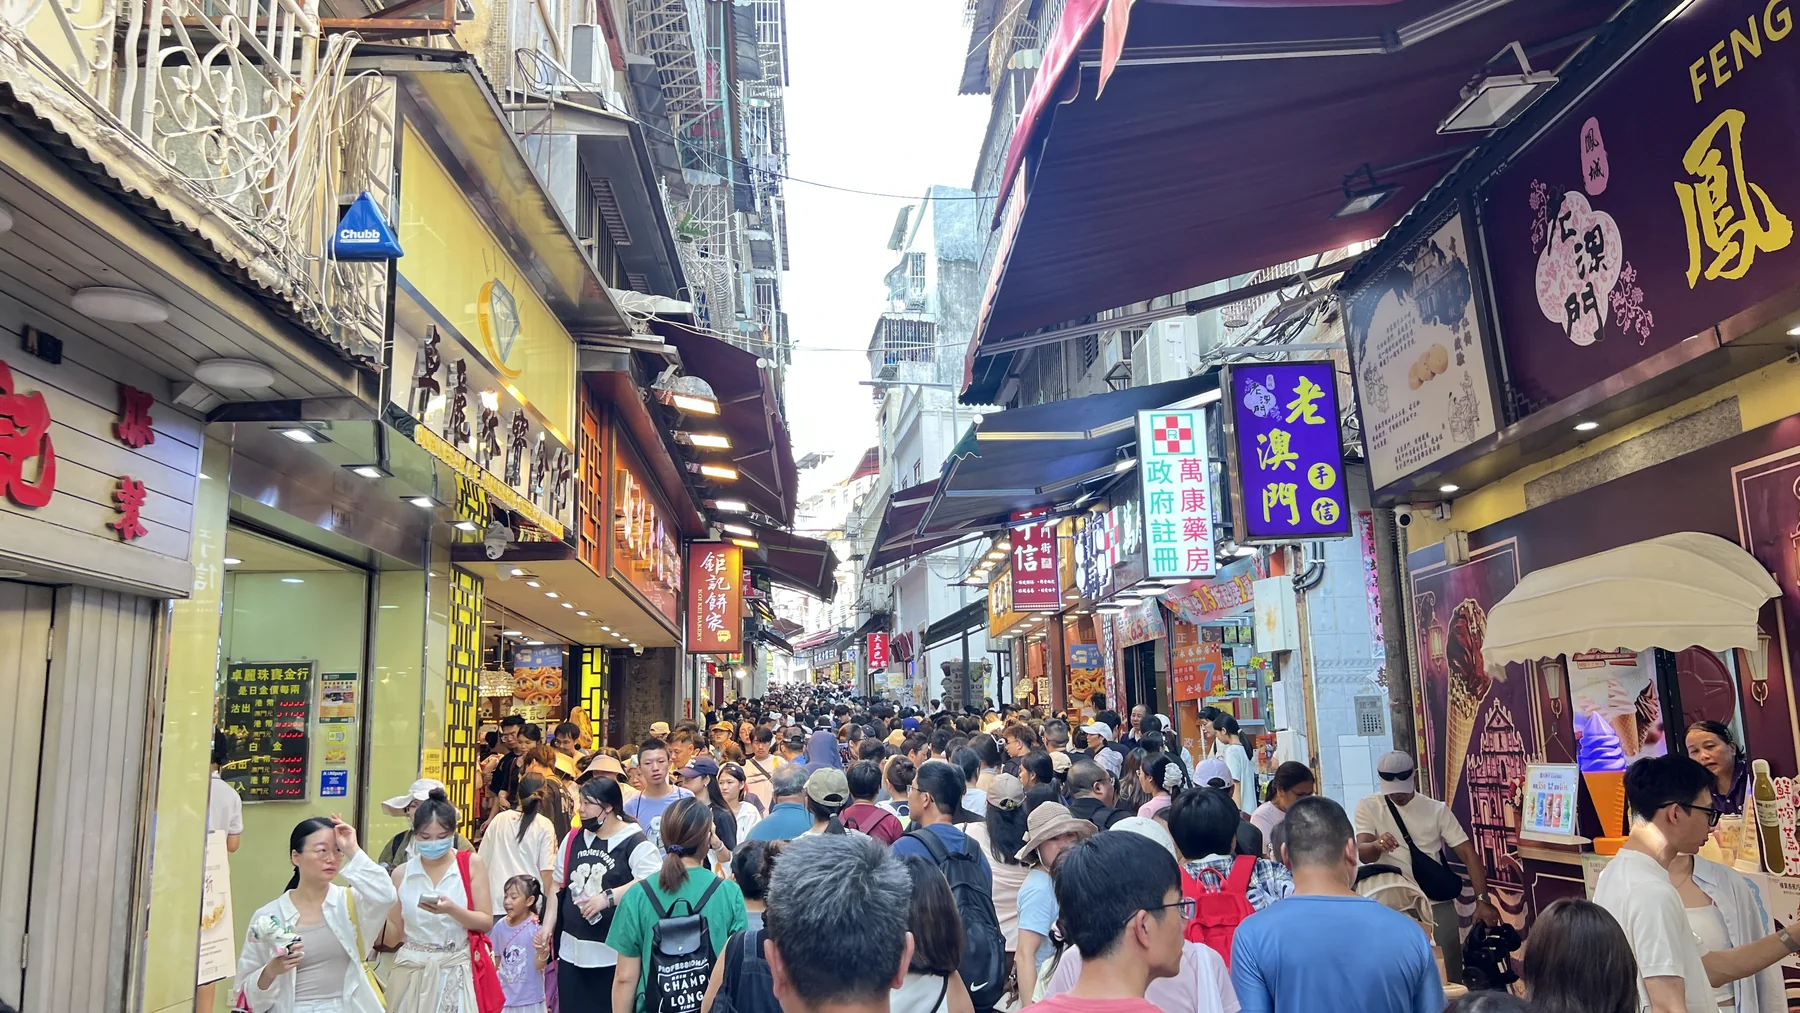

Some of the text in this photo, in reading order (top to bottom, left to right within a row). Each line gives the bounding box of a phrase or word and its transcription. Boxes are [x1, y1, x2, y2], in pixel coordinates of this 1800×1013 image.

[1688, 0, 1793, 104] FENG
[1585, 128, 1604, 181] 鳳城
[1673, 108, 1794, 289] 鳳
[340, 229, 381, 239] Chubb
[1257, 376, 1326, 526] 老澳門
[1147, 459, 1179, 573] 政府註冊
[1178, 458, 1210, 572] 萬康藥房
[1313, 465, 1334, 522] 手信
[700, 551, 731, 632] 鉅記餅家
[1197, 662, 1216, 691] 7
[663, 974, 706, 992] CHAMP
[671, 990, 705, 1007] LONG
